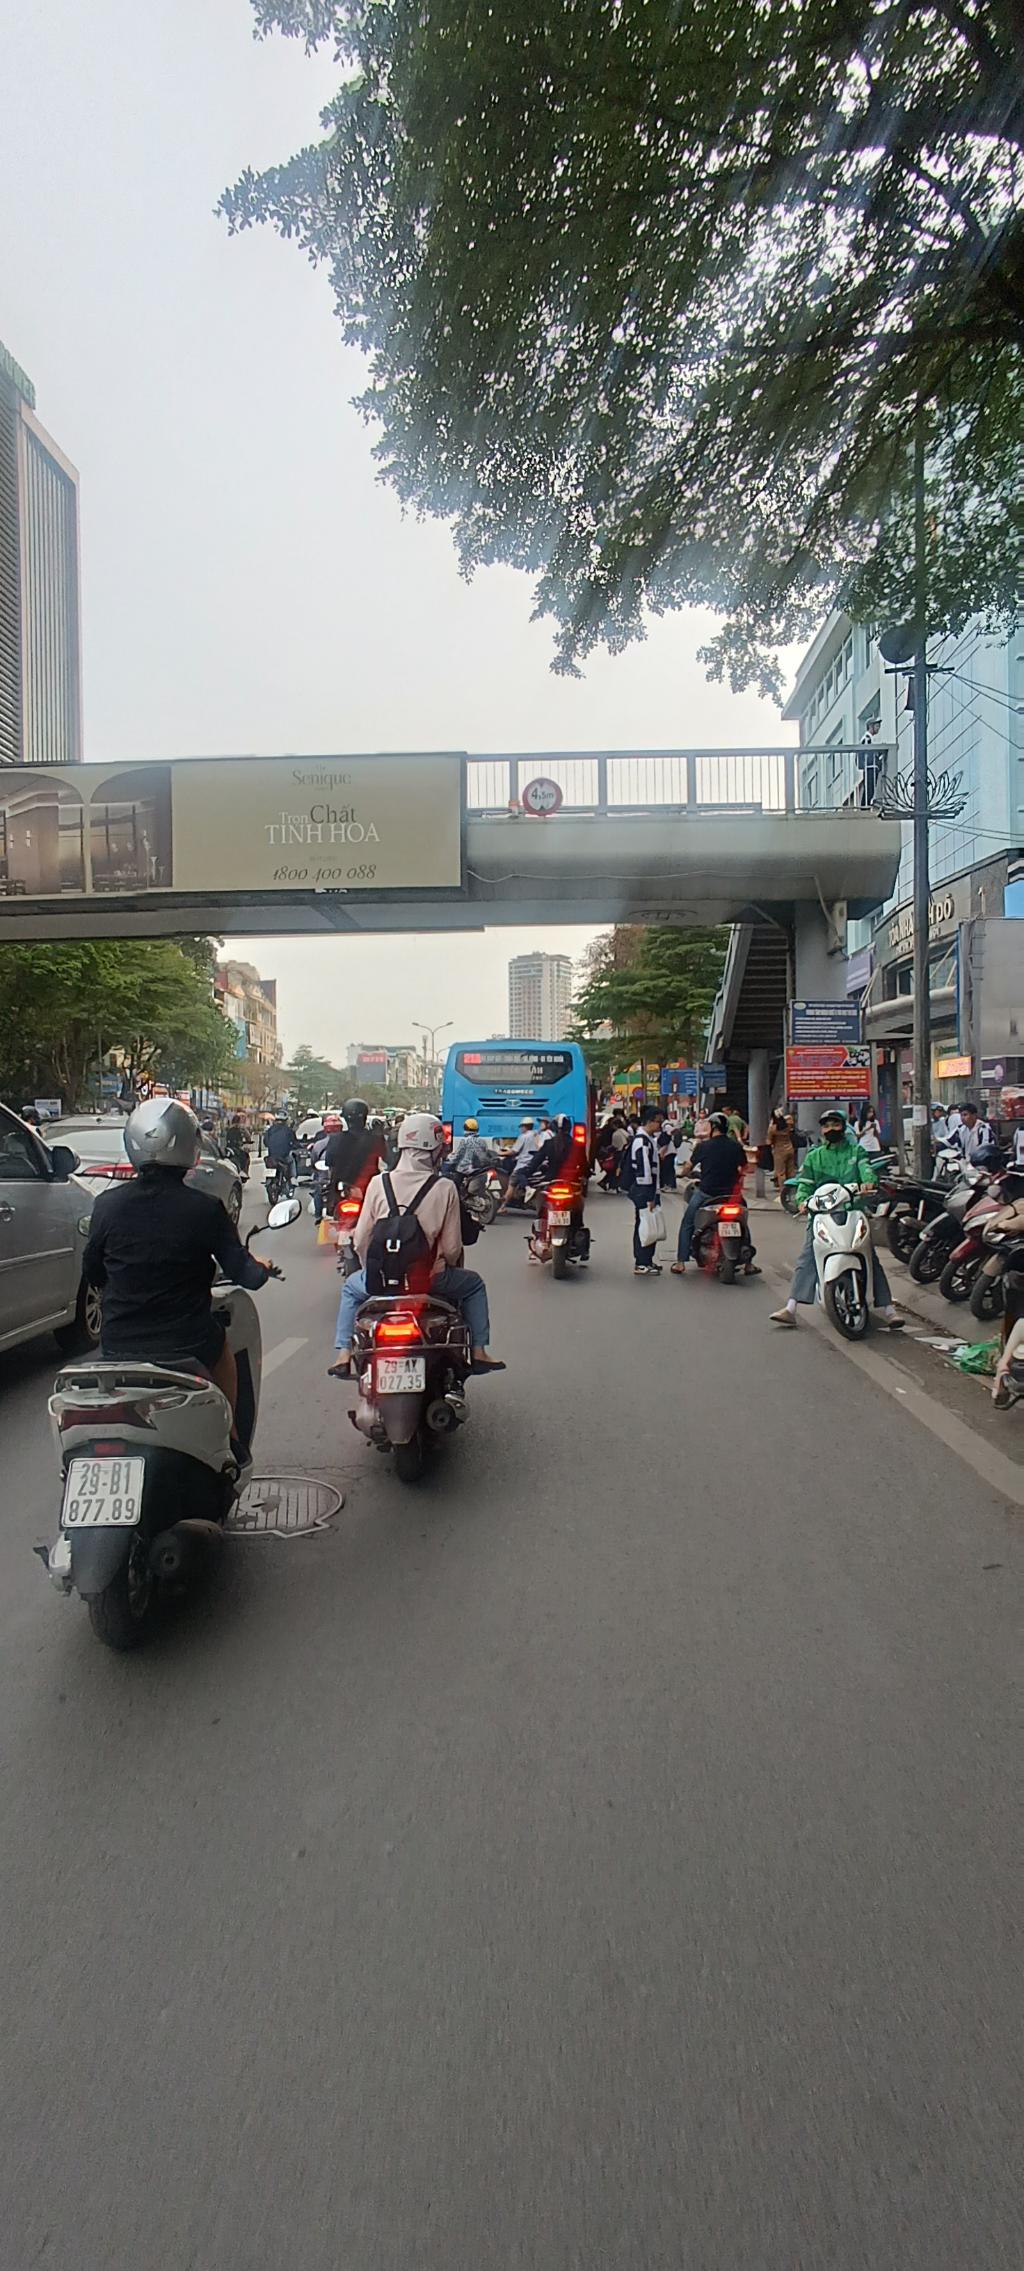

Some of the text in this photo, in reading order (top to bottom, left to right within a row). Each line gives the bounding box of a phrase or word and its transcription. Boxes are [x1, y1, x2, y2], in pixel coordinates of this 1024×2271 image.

[310, 803, 357, 824] Chất
[264, 822, 380, 844] TINH HOA
[273, 865, 308, 881] 1800
[346, 863, 377, 880] 088
[380, 1374, 422, 1390] 027.35
[77, 1462, 131, 1496] 29-B1
[68, 1498, 135, 1522] 877.89
